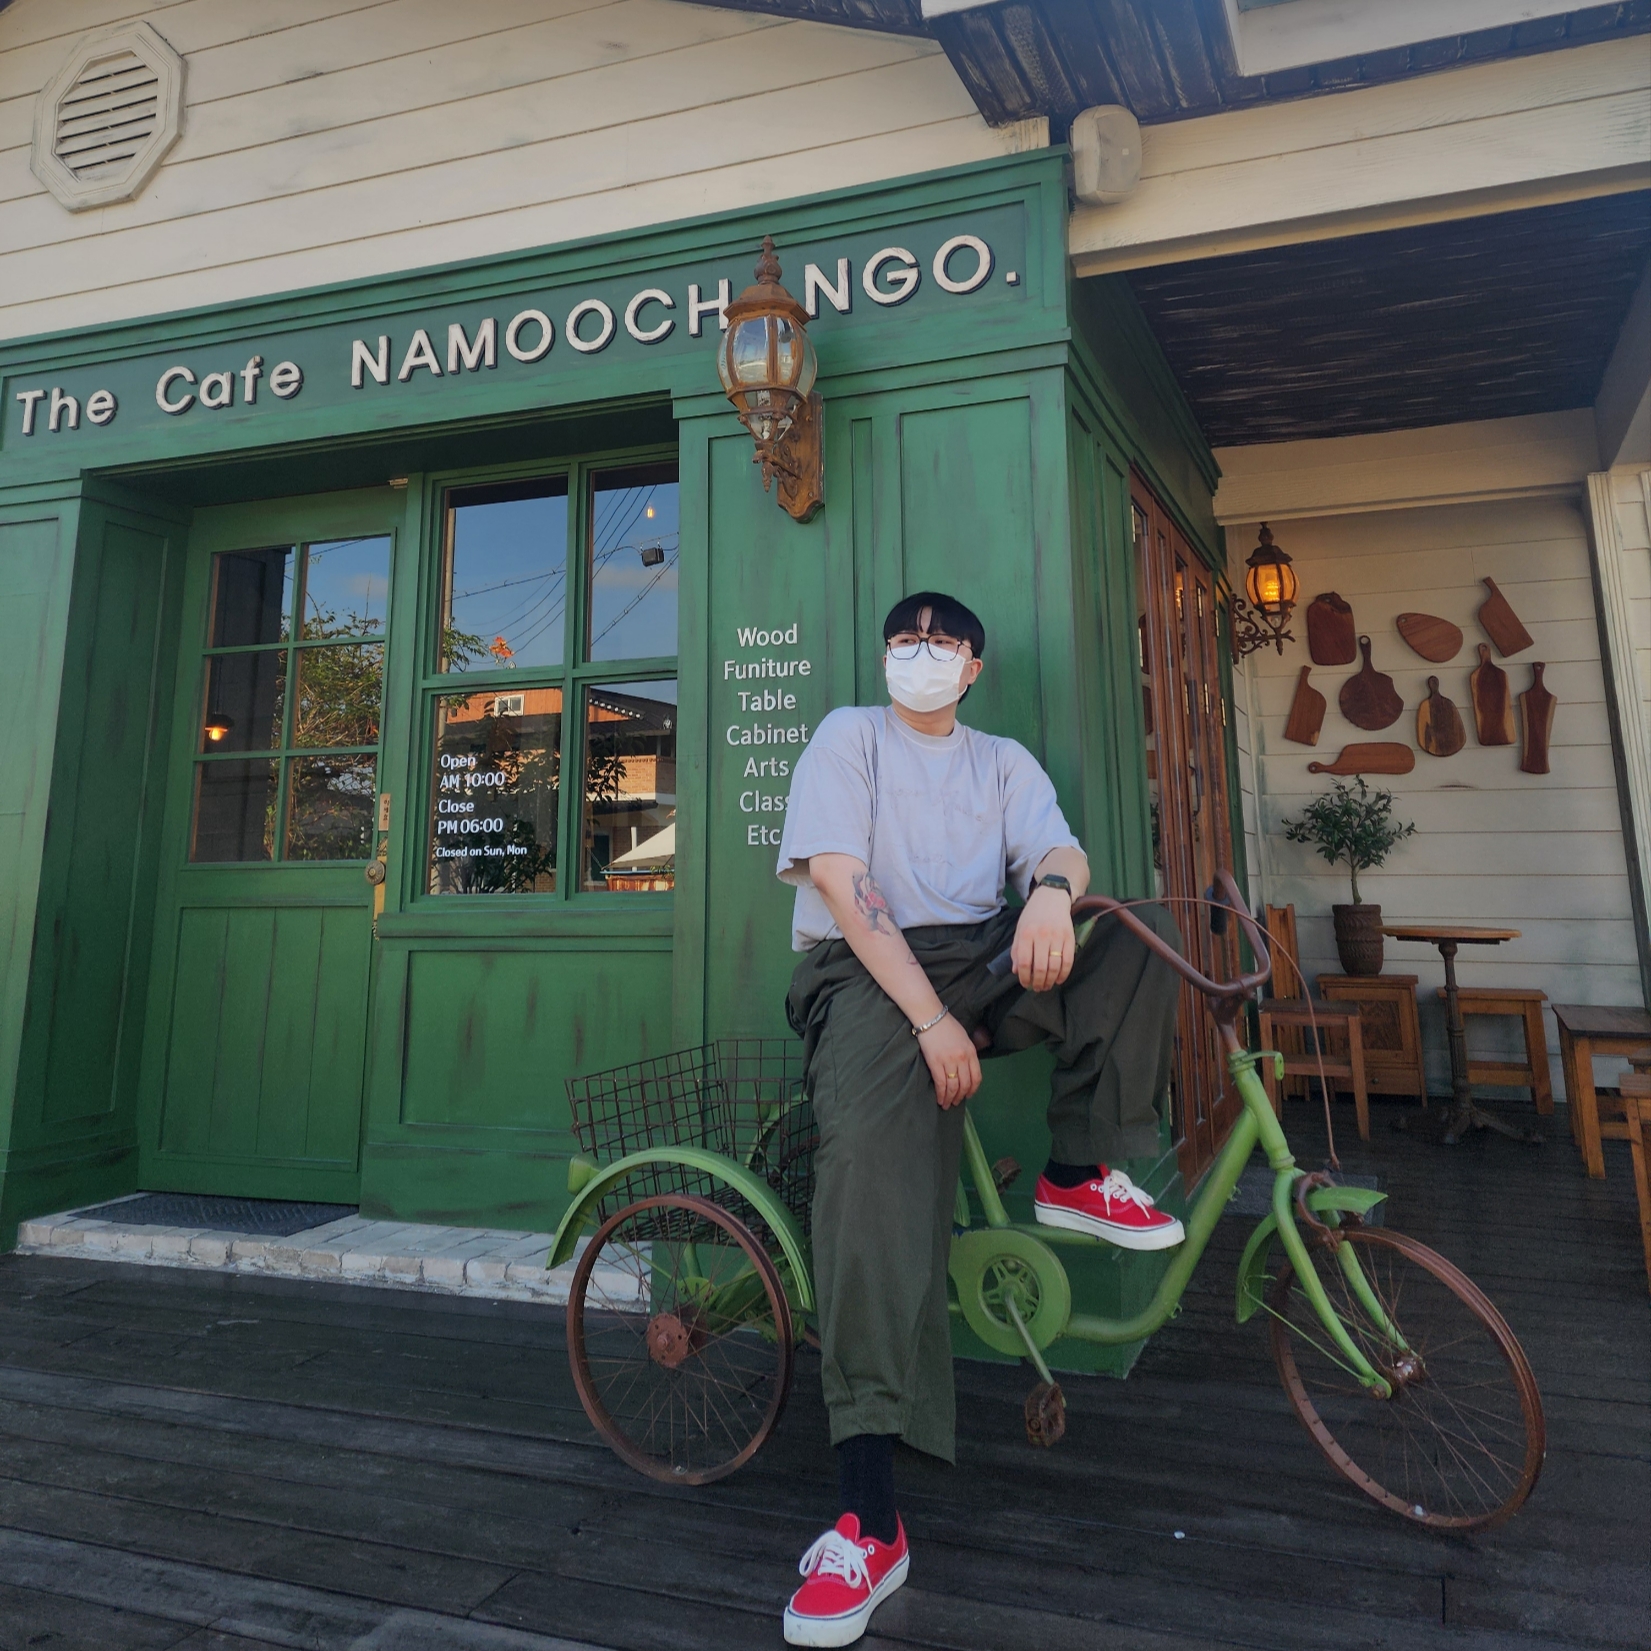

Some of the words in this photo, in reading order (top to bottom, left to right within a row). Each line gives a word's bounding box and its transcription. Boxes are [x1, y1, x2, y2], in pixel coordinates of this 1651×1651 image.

[16, 387, 118, 436] The
[155, 355, 303, 416] Cafe
[351, 234, 1021, 390] NAMOOCHNGO.
[737, 623, 798, 647] Wood
[724, 658, 811, 680] Funiture
[737, 689, 797, 712] Table
[726, 723, 809, 746] Cabinet
[440, 754, 476, 770] Open
[743, 757, 789, 778] Arts
[440, 774, 460, 788] AM
[465, 772, 505, 787] 10:00
[438, 800, 474, 813] Close
[437, 820, 458, 835] PM
[460, 818, 503, 834] 06:00
[747, 824, 781, 845] Etc
[436, 846, 468, 857] Closed
[483, 845, 505, 857] Sun,
[506, 844, 527, 855] Mon
